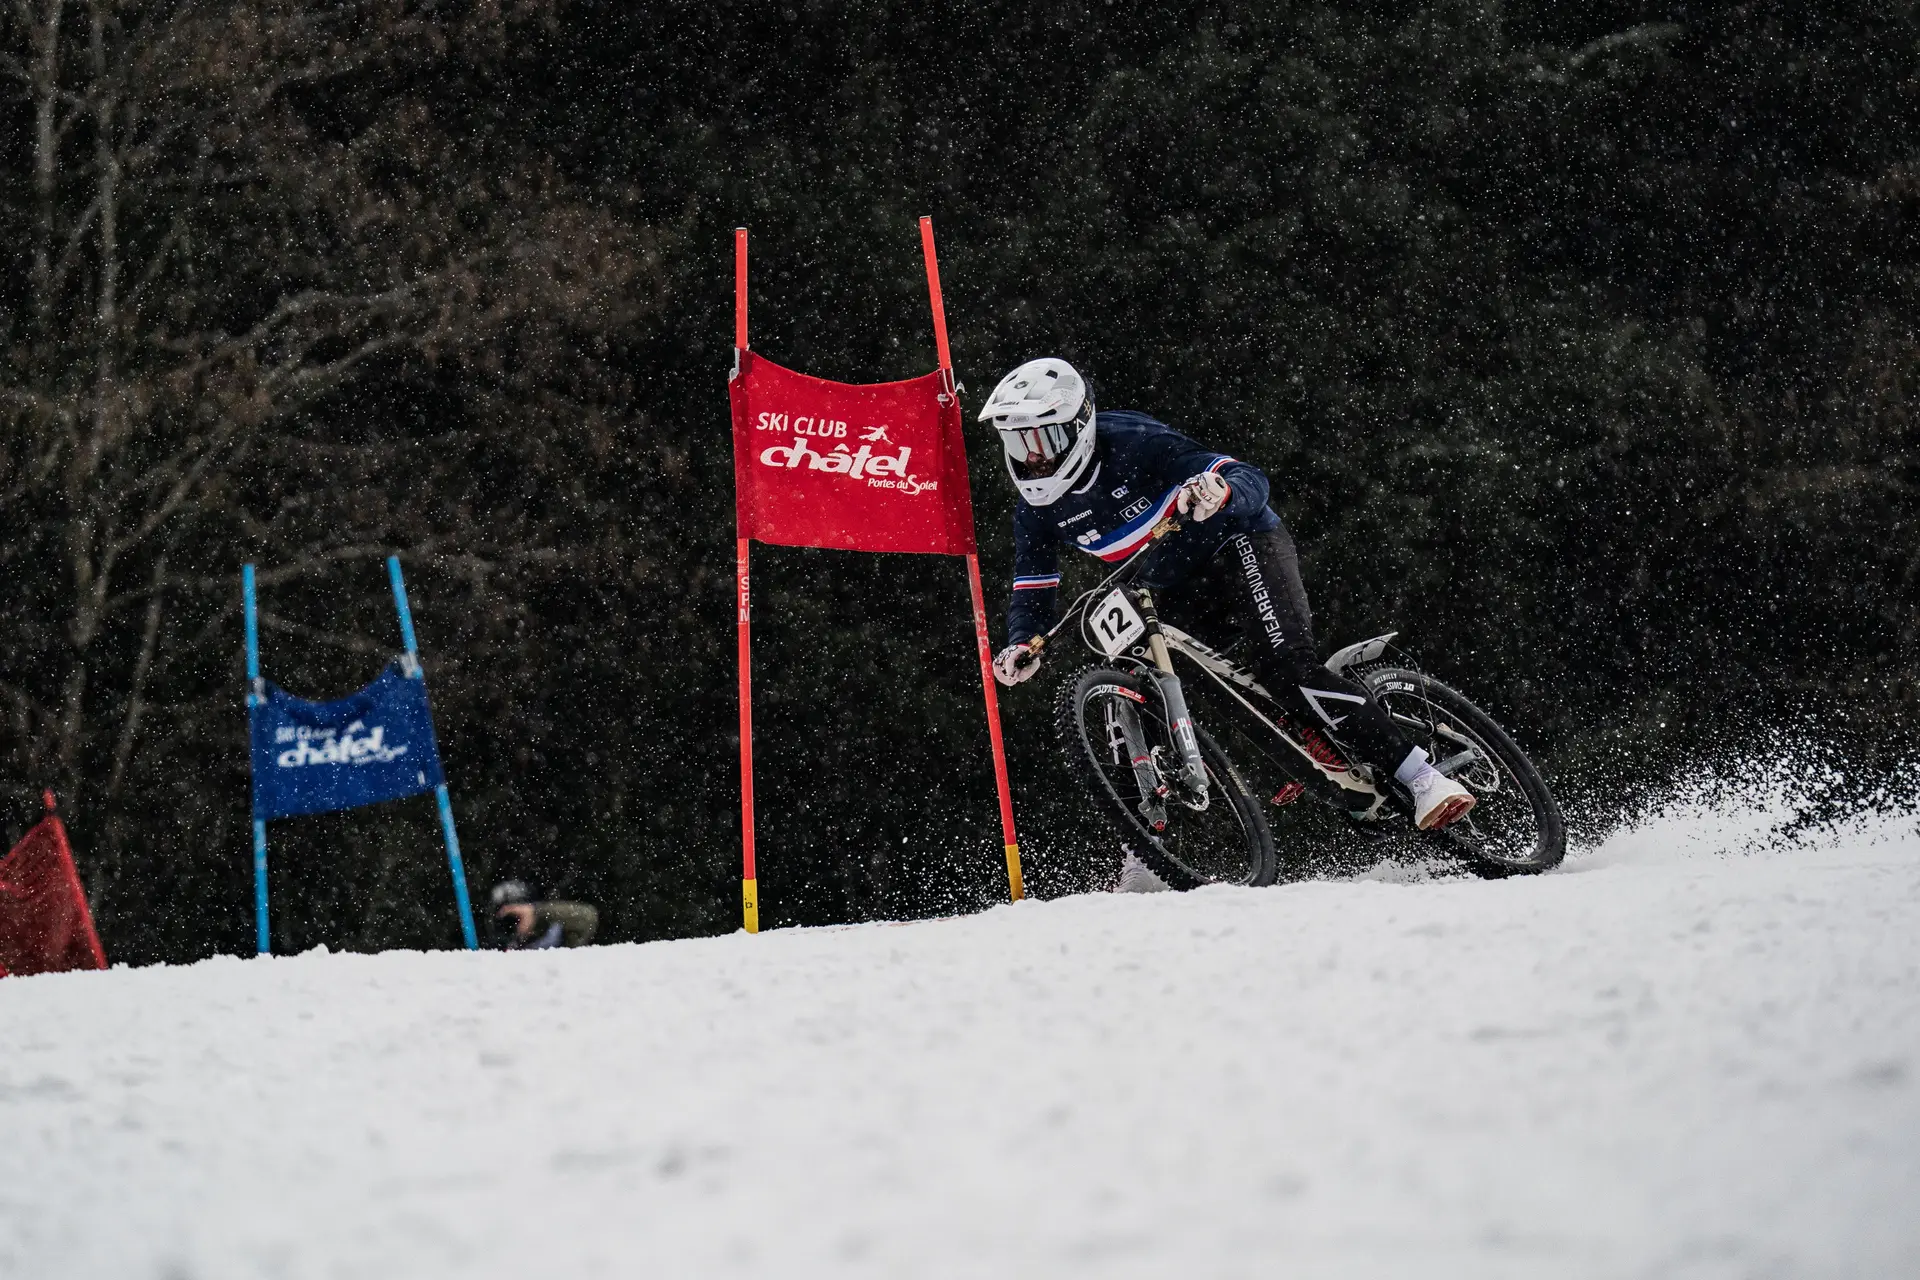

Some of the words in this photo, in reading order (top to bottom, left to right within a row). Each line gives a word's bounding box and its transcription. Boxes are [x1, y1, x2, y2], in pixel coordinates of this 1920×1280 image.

[756, 412, 789, 432] SKI
[793, 417, 848, 438] CLUB
[760, 437, 912, 480] châtel
[867, 478, 896, 489] Portes
[896, 480, 908, 490] du
[907, 474, 938, 496] Soleil
[1124, 500, 1148, 519] CIC
[1099, 606, 1133, 642] 12
